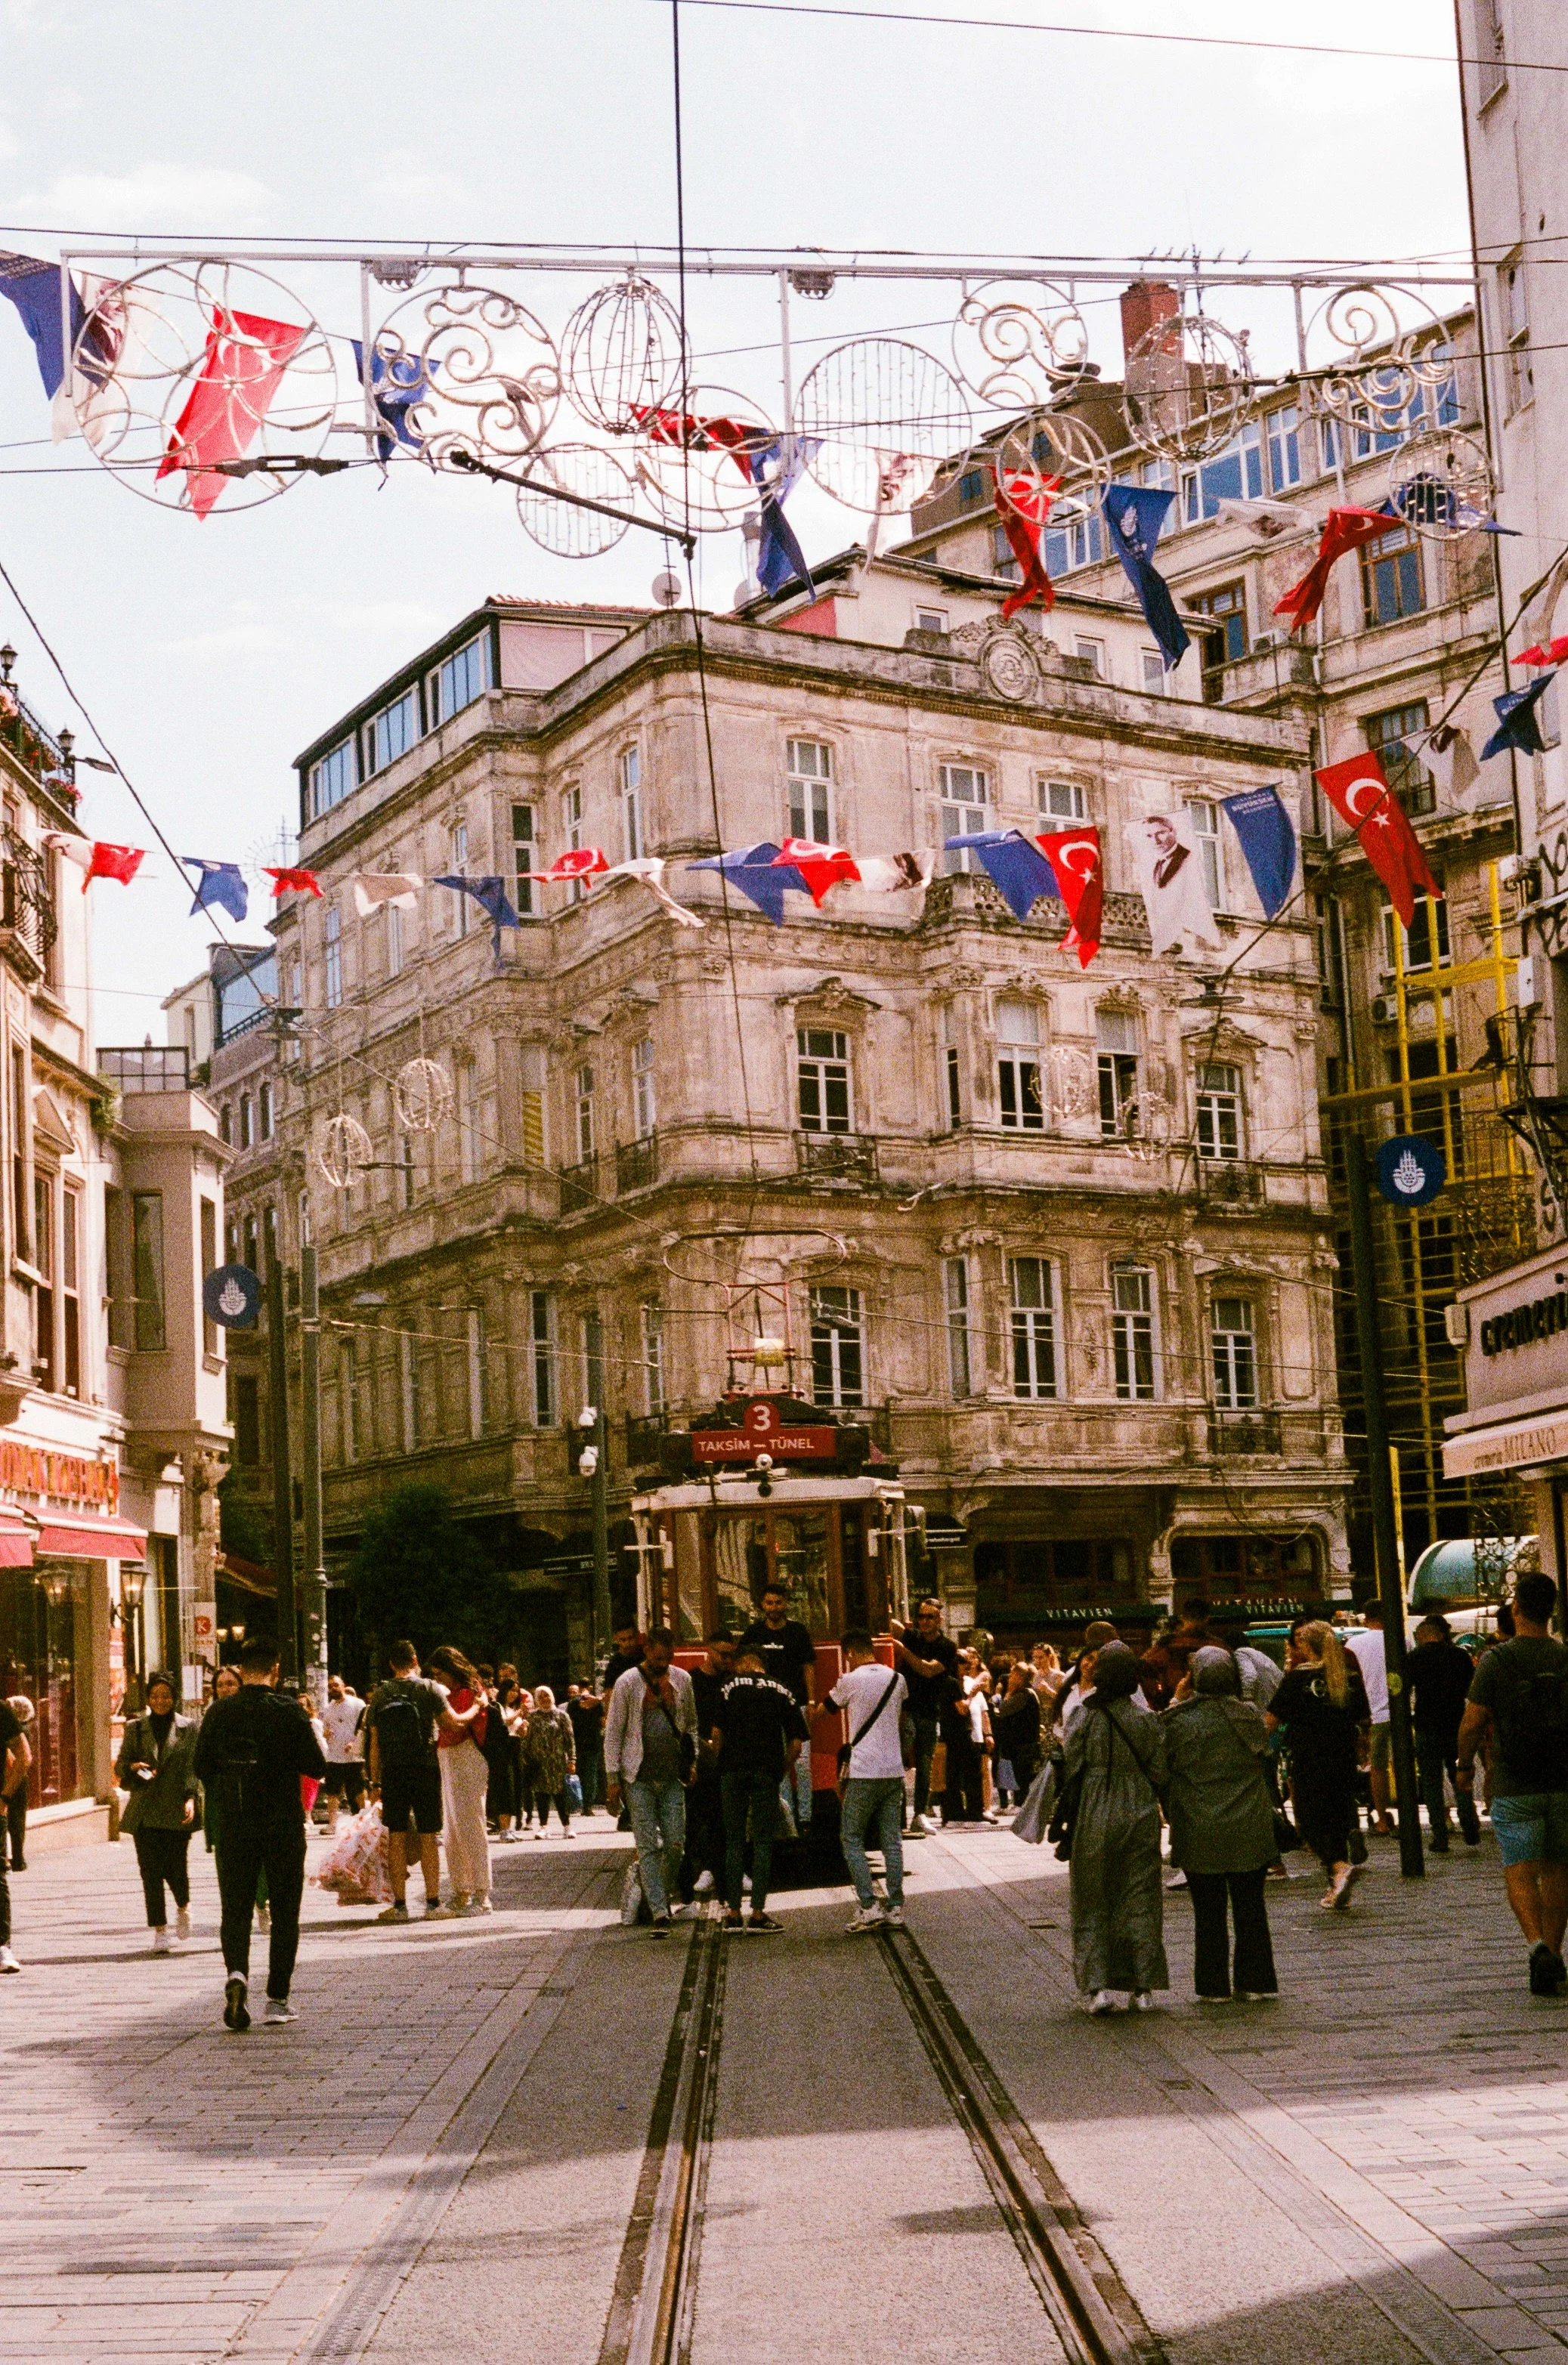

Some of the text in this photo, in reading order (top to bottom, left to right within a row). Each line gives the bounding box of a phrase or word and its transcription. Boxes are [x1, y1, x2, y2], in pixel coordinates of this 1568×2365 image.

[1481, 1272, 1568, 1356] cremeri
[752, 1405, 772, 1431] 3
[698, 1437, 750, 1451] TAKSİM
[768, 1436, 815, 1449] TÜNEL
[1504, 1427, 1557, 1463] MILANO
[1046, 1607, 1113, 1618] VITAVIEN
